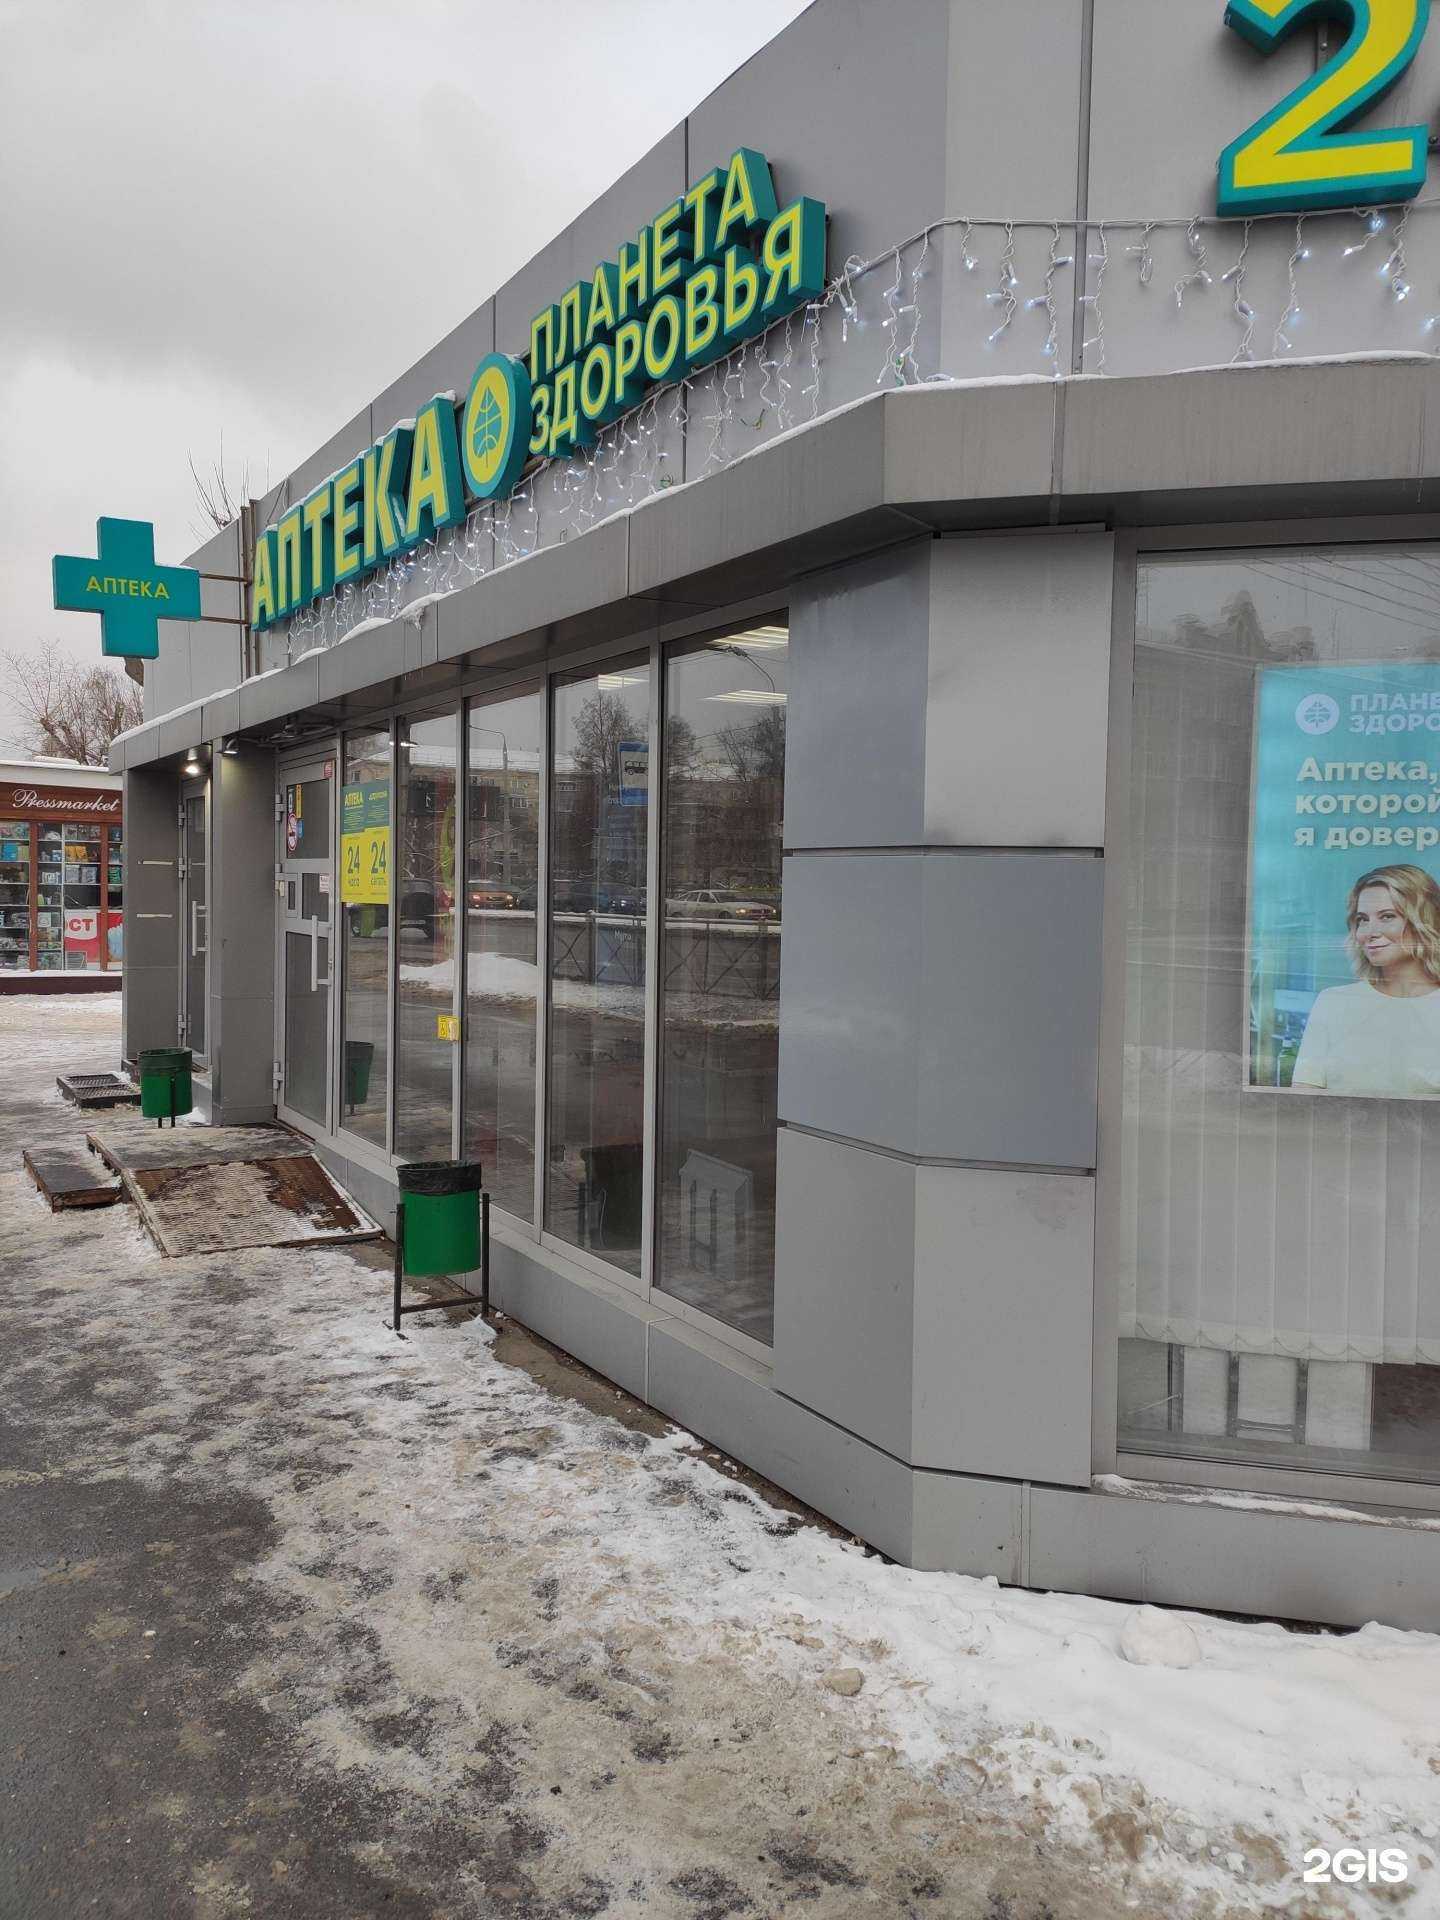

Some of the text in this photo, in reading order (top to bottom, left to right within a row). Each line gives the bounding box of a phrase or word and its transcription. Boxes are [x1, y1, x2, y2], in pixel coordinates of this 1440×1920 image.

[1217, 0, 1430, 218] 2
[529, 147, 777, 382] ПЛАНЕТА
[529, 197, 826, 458] ЗДОРОВЬЯ
[251, 396, 467, 632] АПТЕКА
[86, 576, 170, 599] АПТЕКА
[1297, 757, 1438, 784] Аптека,
[12, 788, 119, 812] Pressmarket
[1295, 786, 1440, 818] которой
[1293, 826, 1439, 851] я довер
[347, 845, 360, 874] 24
[371, 840, 387, 874] 24
[65, 918, 94, 932] СТ
